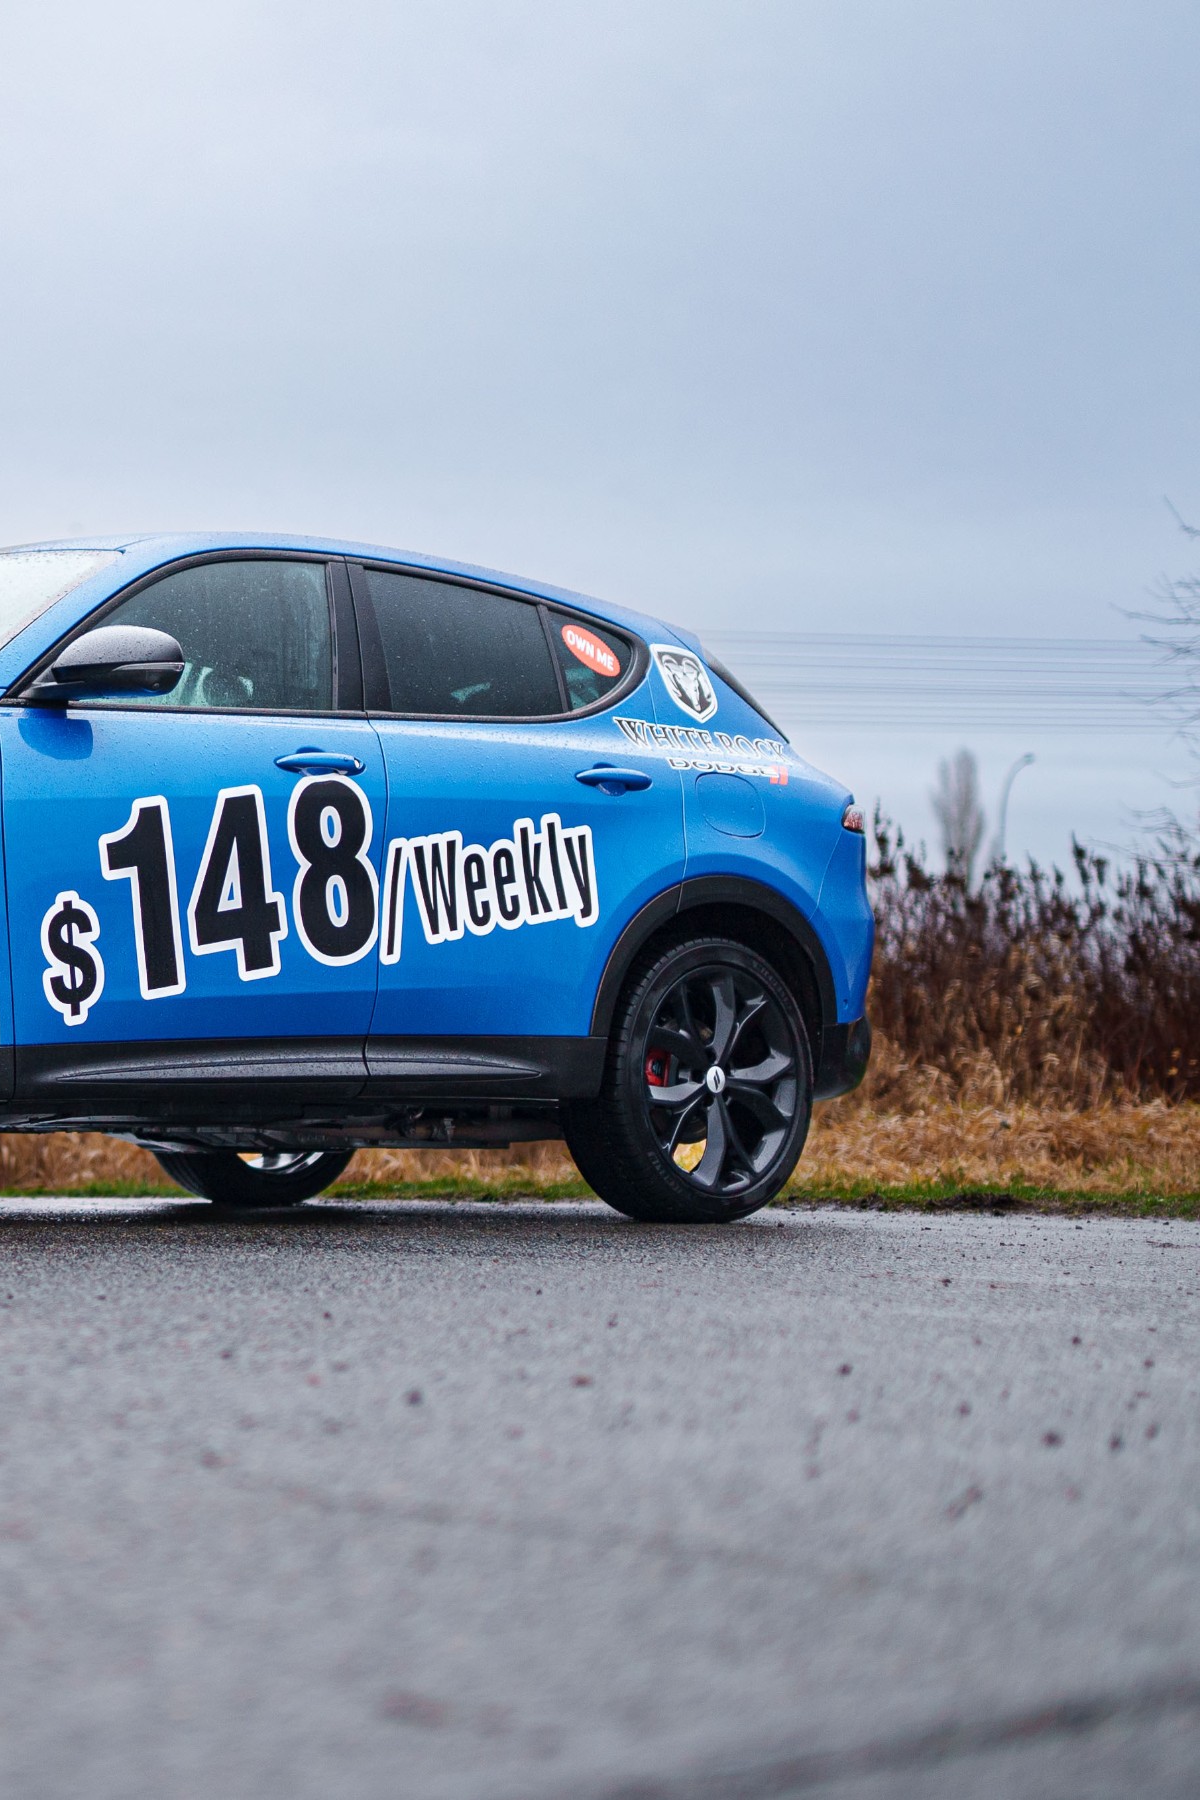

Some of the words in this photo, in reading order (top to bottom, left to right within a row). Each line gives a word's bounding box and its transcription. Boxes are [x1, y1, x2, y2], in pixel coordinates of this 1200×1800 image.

[565, 629, 594, 659] OWN
[593, 646, 616, 672] ME
[613, 717, 716, 755] WHITE
[715, 732, 791, 764] ROCK
[668, 758, 779, 777] DODGE
